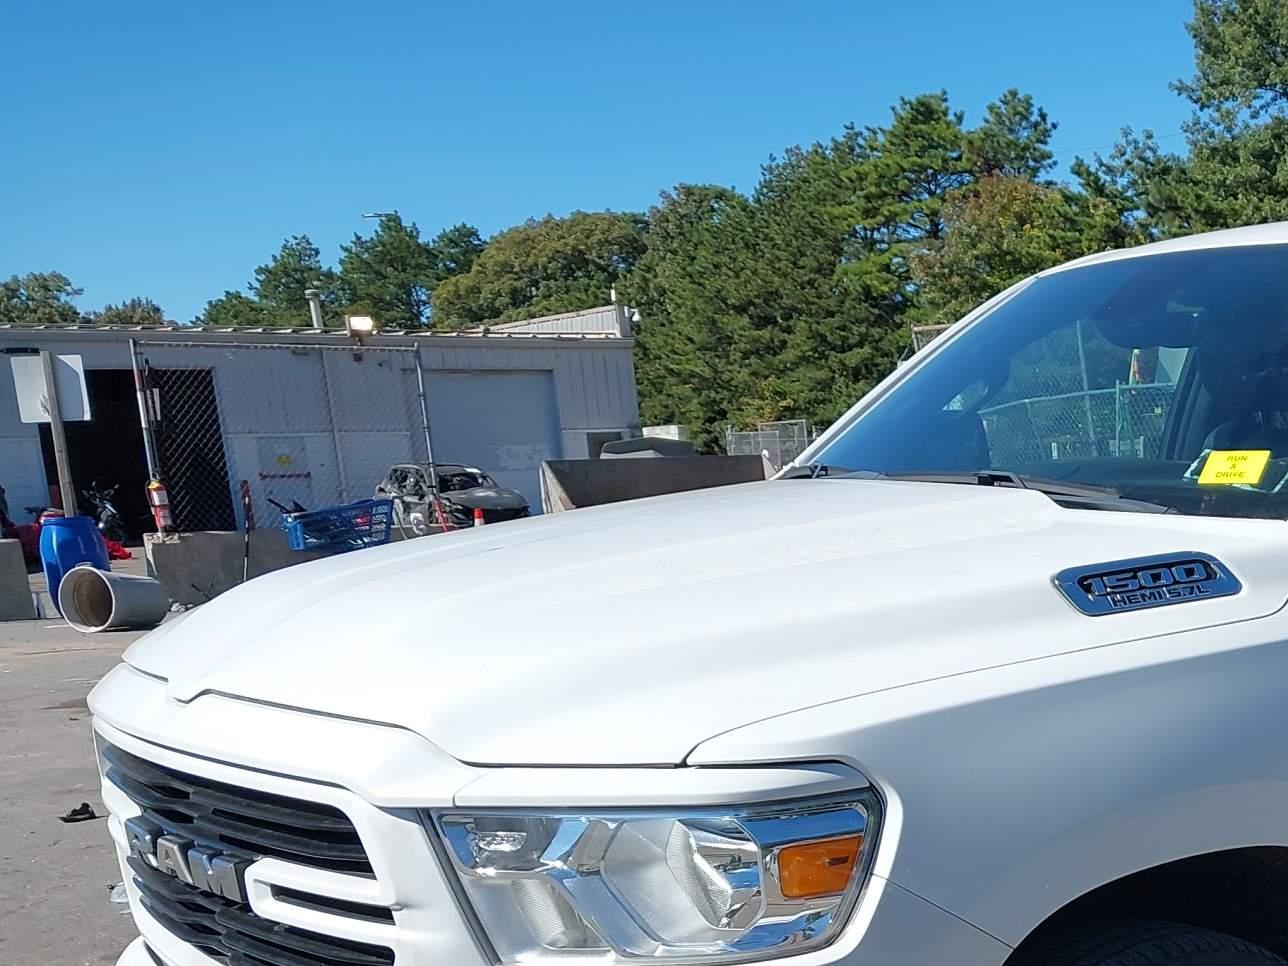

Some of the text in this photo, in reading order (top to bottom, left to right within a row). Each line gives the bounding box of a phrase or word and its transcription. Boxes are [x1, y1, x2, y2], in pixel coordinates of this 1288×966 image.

[1084, 562, 1209, 596] 1500
[1107, 584, 1211, 609] HEMI 5.7L
[124, 815, 246, 904] RAM
